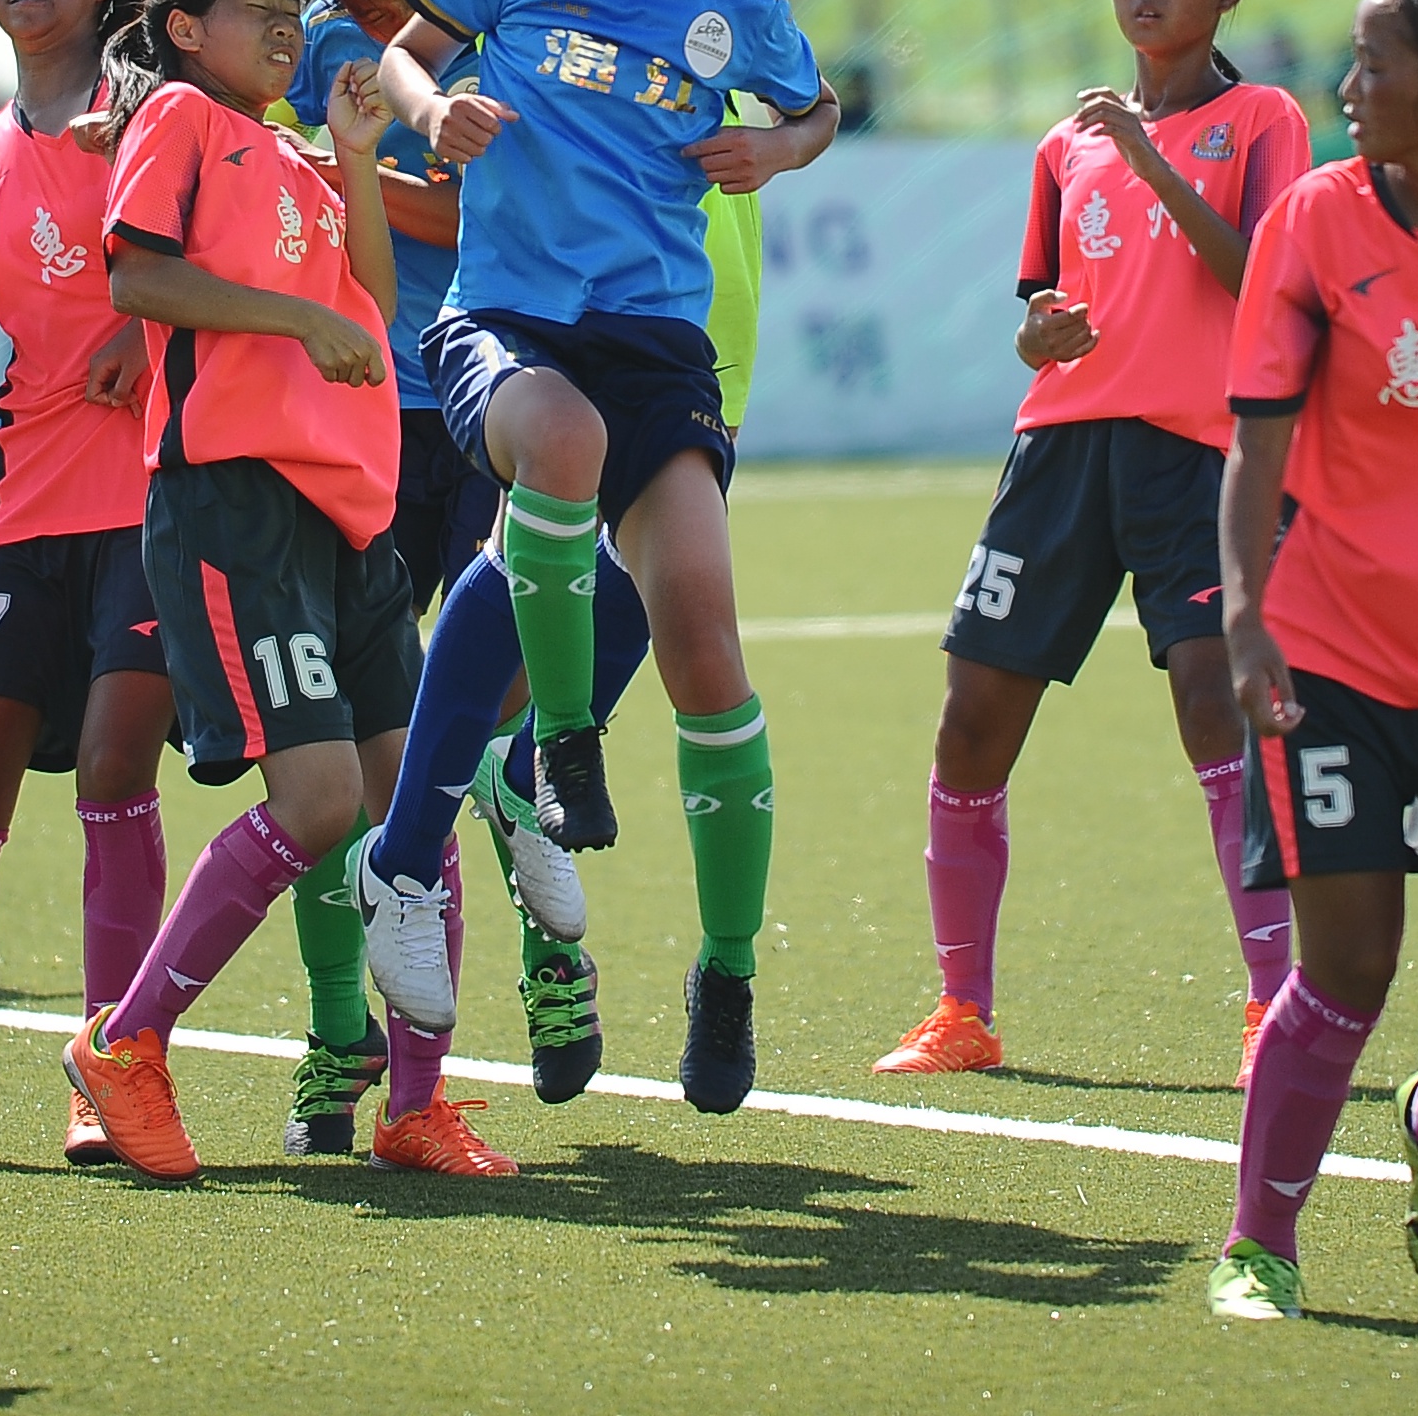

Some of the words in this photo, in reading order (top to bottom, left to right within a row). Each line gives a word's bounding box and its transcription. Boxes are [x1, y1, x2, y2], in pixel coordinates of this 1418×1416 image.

[30, 206, 87, 285] 惠
[954, 544, 1024, 621] 25
[253, 633, 338, 709] 16
[1298, 745, 1356, 829] 5
